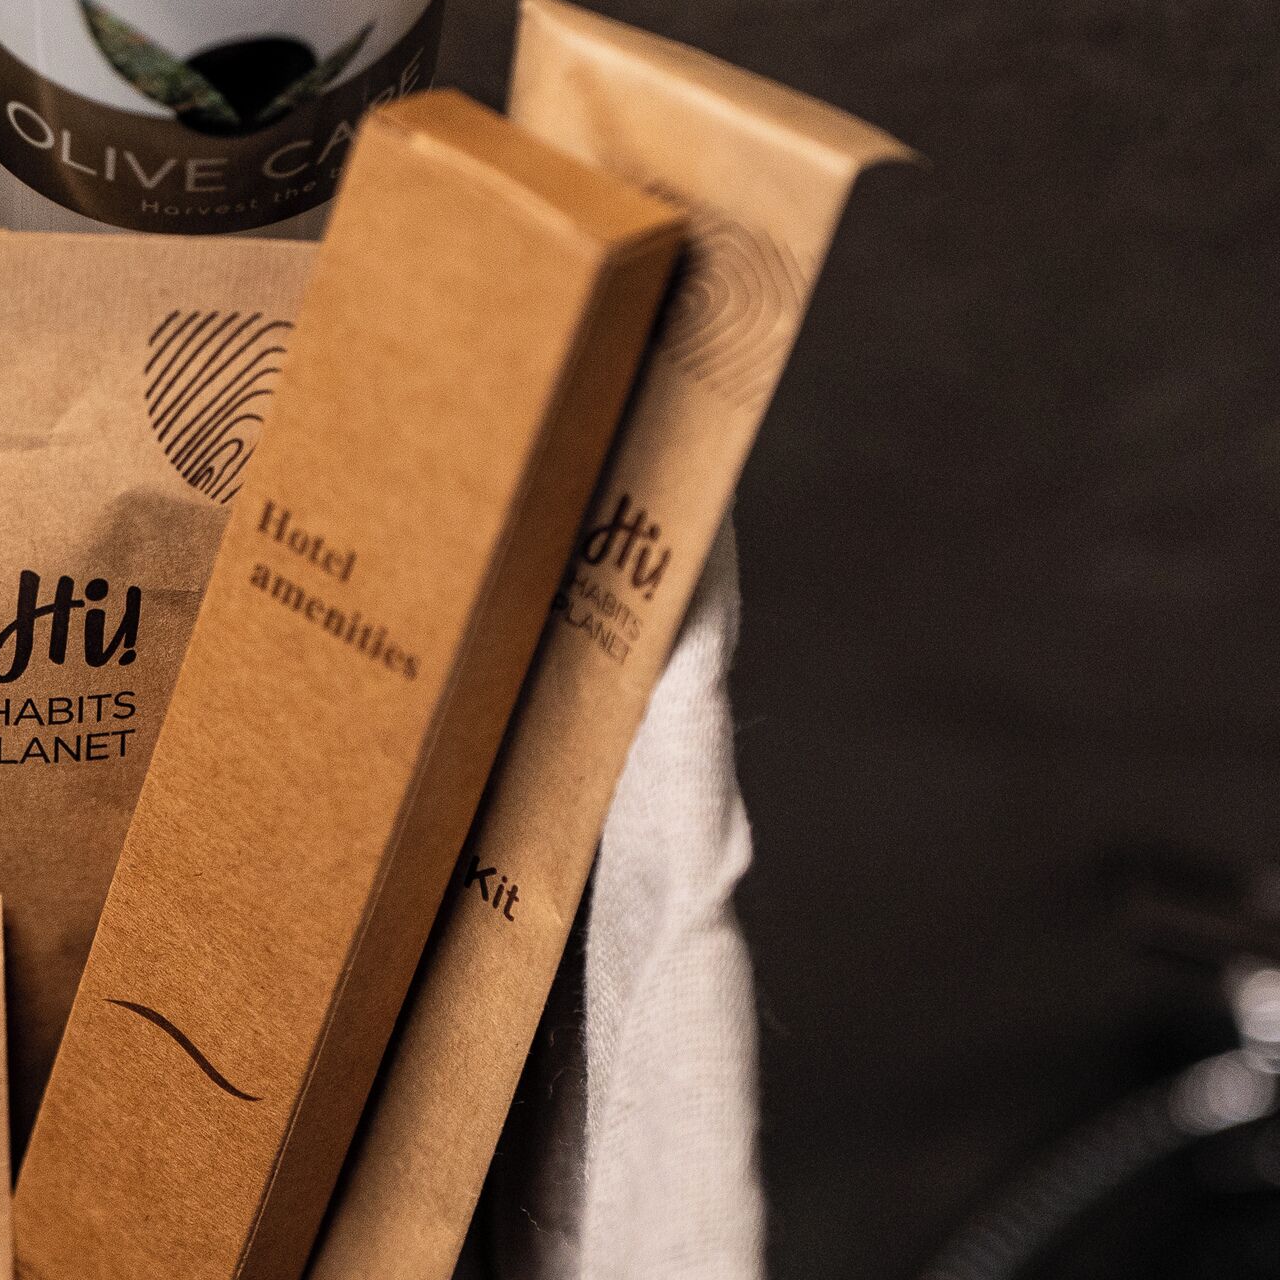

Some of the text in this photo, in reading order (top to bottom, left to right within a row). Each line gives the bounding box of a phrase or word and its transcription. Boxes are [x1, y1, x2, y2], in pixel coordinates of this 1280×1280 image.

[5, 100, 229, 193] OLIVE
[140, 197, 259, 216] Harvest
[257, 500, 358, 584] Hotel
[249, 560, 419, 682] amenities
[463, 855, 520, 922] Kit
